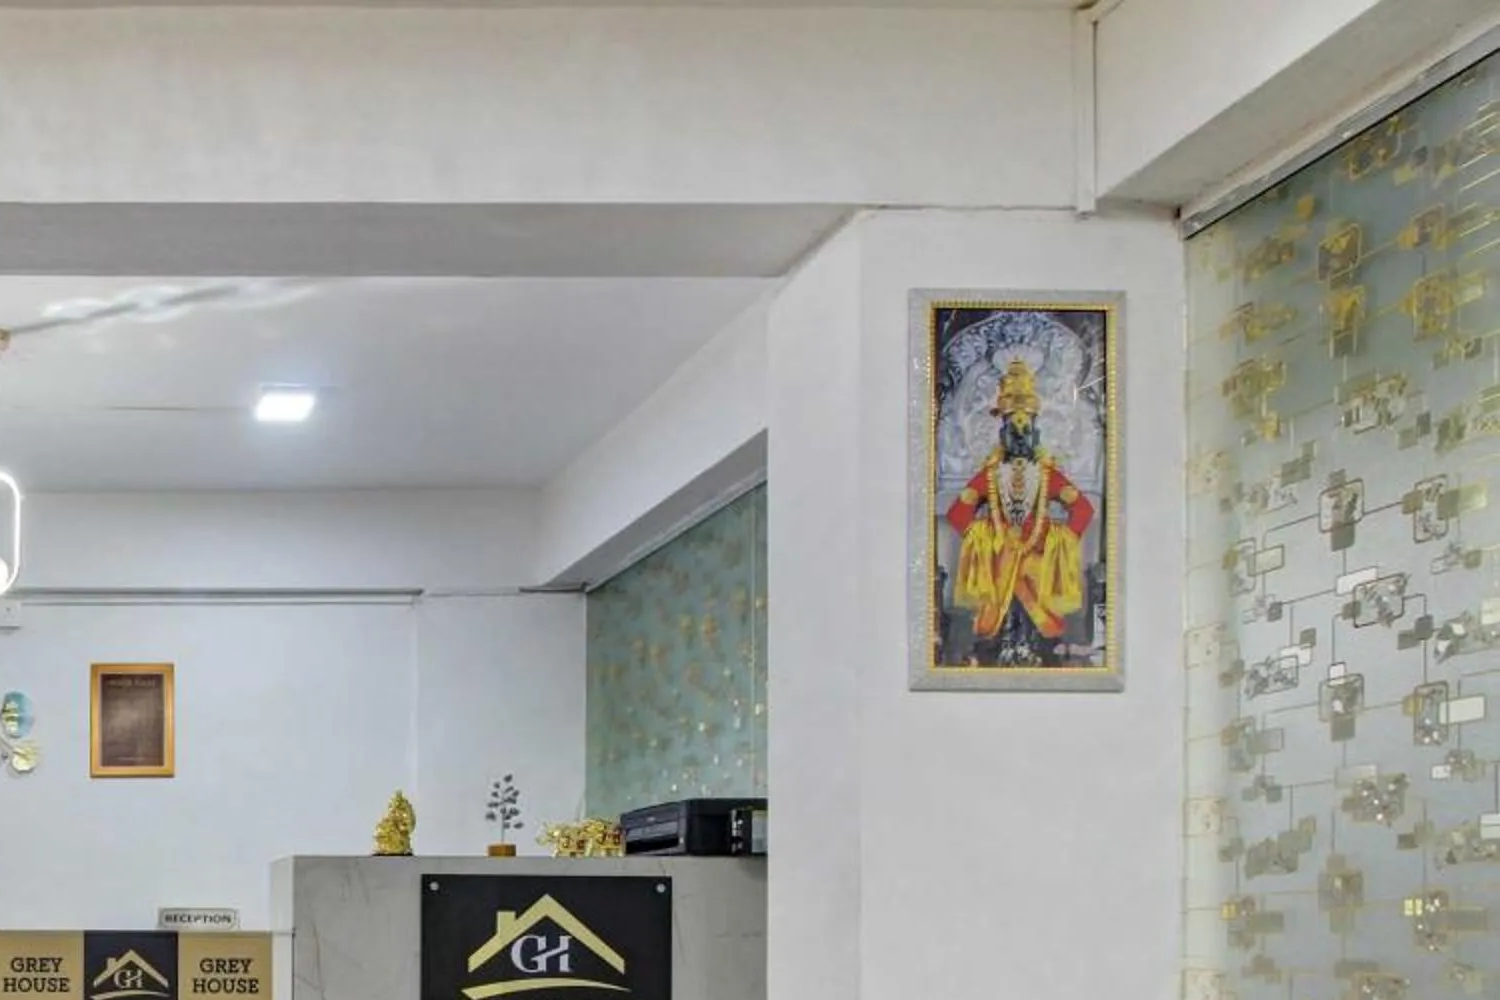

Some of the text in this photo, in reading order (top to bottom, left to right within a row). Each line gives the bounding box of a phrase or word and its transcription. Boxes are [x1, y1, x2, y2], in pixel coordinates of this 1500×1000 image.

[164, 913, 232, 924] RECEPTION
[510, 934, 573, 974] GH
[9, 957, 63, 972] GREY
[199, 958, 253, 974] GREY
[3, 977, 71, 993] HOUSE
[192, 978, 260, 995] HOUSE
